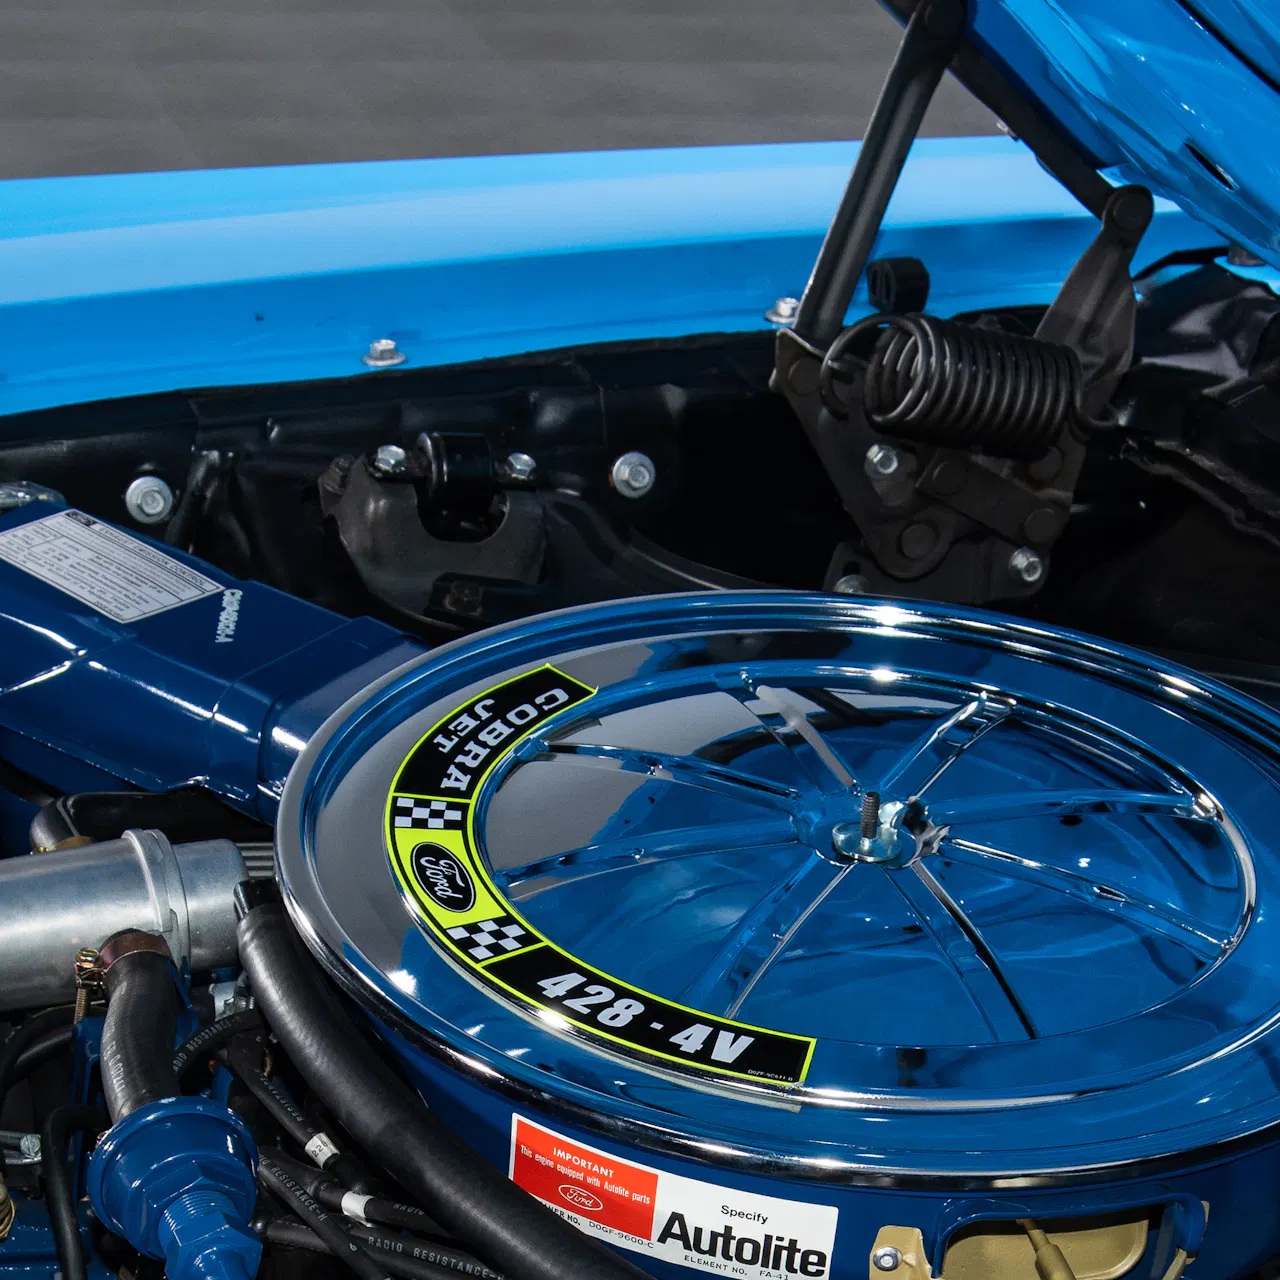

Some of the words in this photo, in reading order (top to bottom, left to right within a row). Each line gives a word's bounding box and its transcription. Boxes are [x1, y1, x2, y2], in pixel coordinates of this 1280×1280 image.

[166, 559, 206, 586] CONTROL
[432, 697, 496, 753] JET
[439, 686, 570, 791] COBRA
[417, 853, 465, 901] Ford
[537, 972, 645, 1029] 428
[669, 1023, 755, 1065] 4V
[520, 1144, 533, 1158] This
[534, 1153, 555, 1169] engine
[556, 1163, 584, 1181] equipped
[586, 1175, 601, 1187] with
[603, 1181, 629, 1198] Autolite
[631, 1192, 651, 1204] parts
[553, 1147, 614, 1178] IMPORTANT
[270, 1157, 327, 1221] RESISTANCE-H
[566, 1213, 581, 1226] NO.
[720, 1204, 769, 1225] Specify
[368, 1235, 404, 1254] RADIO
[656, 1210, 827, 1278] Autolite
[683, 1255, 728, 1273] ELEMENT
[731, 1266, 748, 1277] NO.
